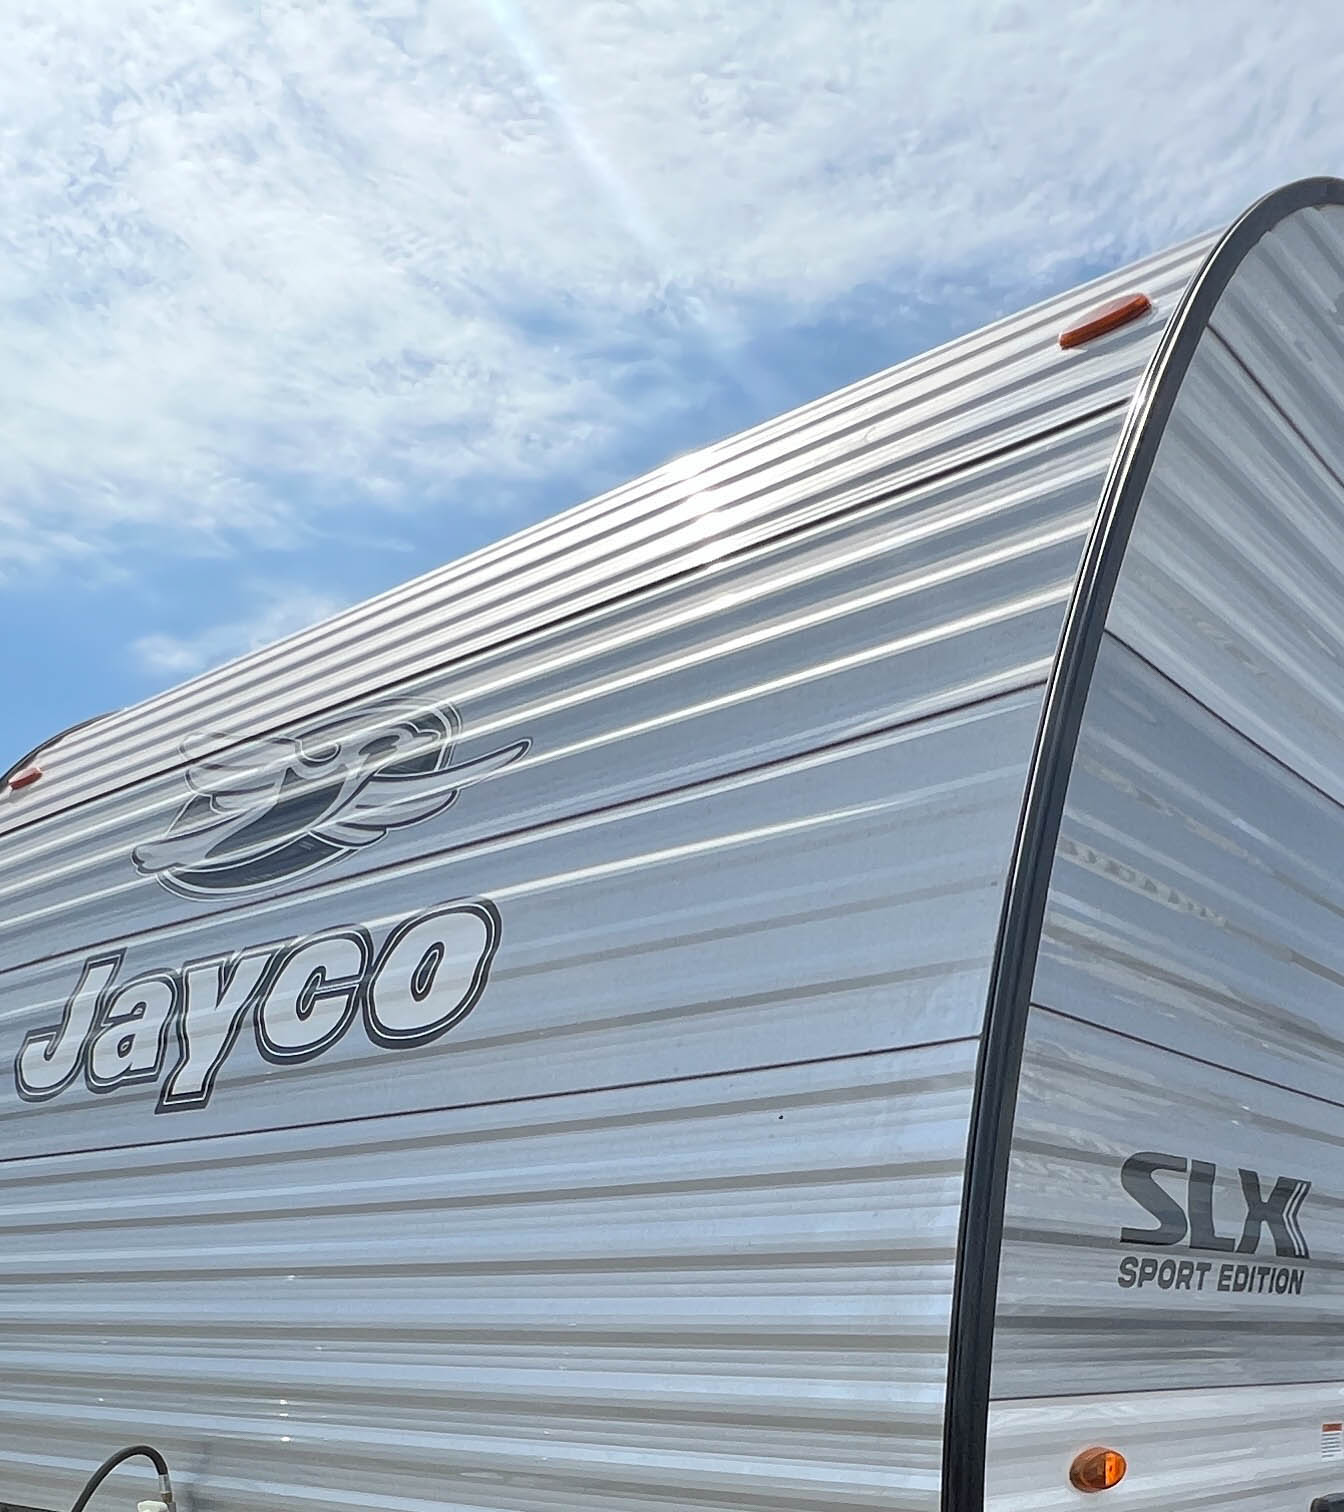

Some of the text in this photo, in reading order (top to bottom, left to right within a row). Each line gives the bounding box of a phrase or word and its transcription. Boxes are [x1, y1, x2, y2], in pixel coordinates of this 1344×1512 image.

[14, 895, 502, 1115] Jayco
[1120, 1151, 1312, 1260] SLX
[1117, 1255, 1305, 1296] SPORT EDITION
